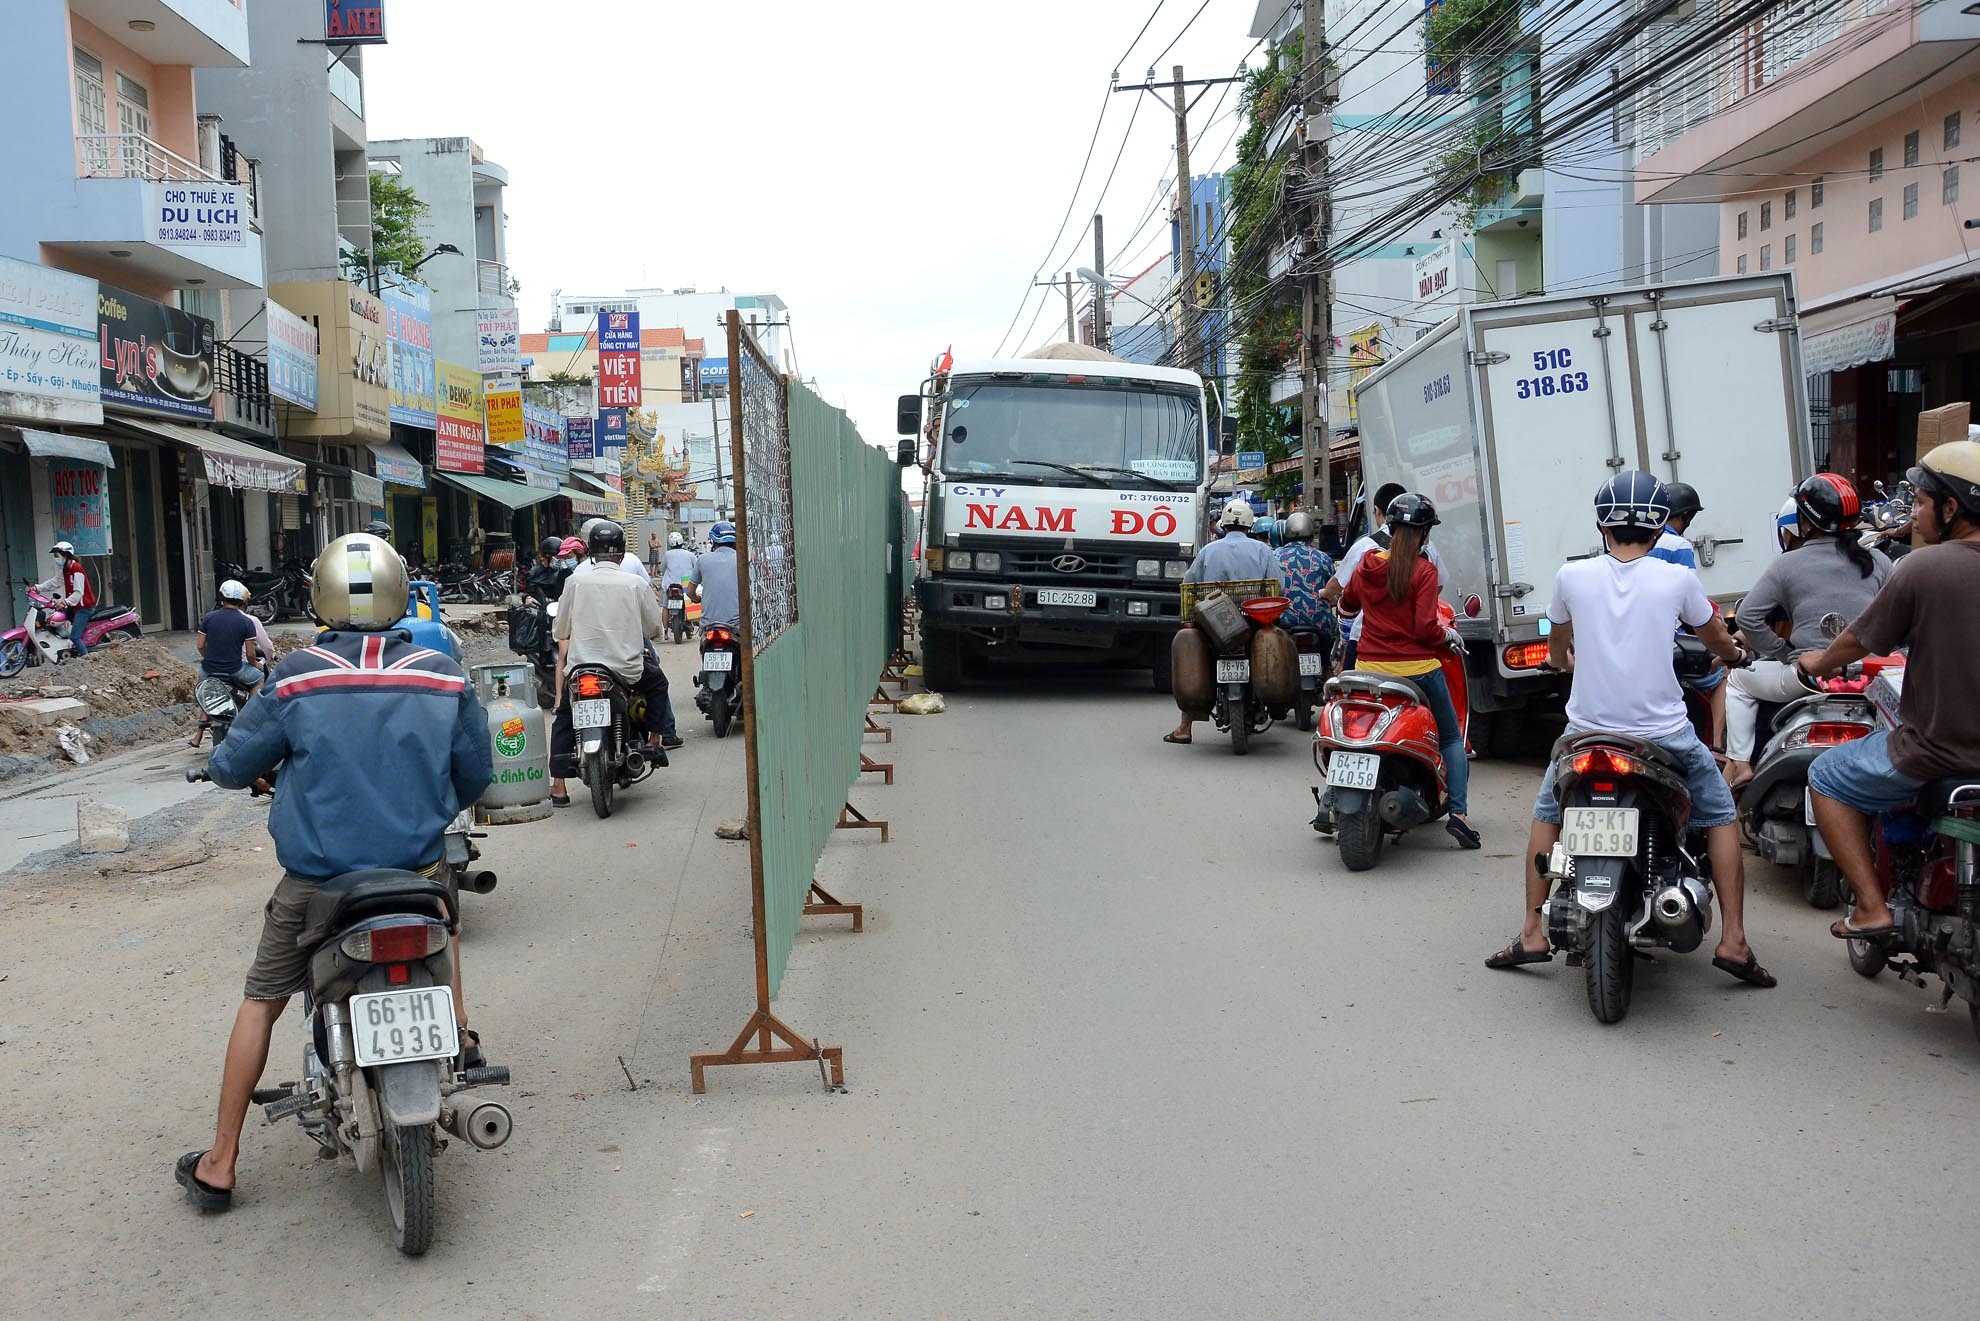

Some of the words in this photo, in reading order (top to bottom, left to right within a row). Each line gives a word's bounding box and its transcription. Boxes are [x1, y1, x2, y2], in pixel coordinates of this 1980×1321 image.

[165, 190, 186, 203] CHO
[190, 189, 217, 204] THUÊ
[221, 192, 235, 204] XE
[162, 207, 189, 223] DU
[197, 208, 239, 227] LỊCH
[97, 293, 127, 321] Coffee
[617, 331, 633, 340] HÀNG
[101, 323, 158, 384] Lyn's
[615, 342, 626, 350] CTY
[603, 353, 637, 380] VIỆT
[1533, 347, 1572, 371] 51C
[50, 375, 65, 390] Gội
[604, 379, 638, 404] TIẾN
[1516, 371, 1589, 399] 318.63
[440, 420, 458, 438] ANH
[460, 423, 482, 442] NGÂN
[953, 486, 1006, 498] C.TY
[1120, 493, 1137, 501] ĐT:
[1139, 494, 1190, 503] 37603732
[964, 503, 1077, 533] NAM
[1109, 504, 1177, 537] ĐÔ
[1221, 661, 1245, 671] 76-V6
[1301, 664, 1316, 674] 557
[577, 701, 604, 715] 54-P6
[578, 713, 605, 726] 5947
[1336, 754, 1371, 771] 64-F1
[1330, 769, 1374, 787] 140.58
[1575, 811, 1626, 831] 43-K1
[1568, 833, 1633, 852] 016.98
[366, 992, 436, 1026] 66-H1
[371, 1024, 443, 1058] 4936
